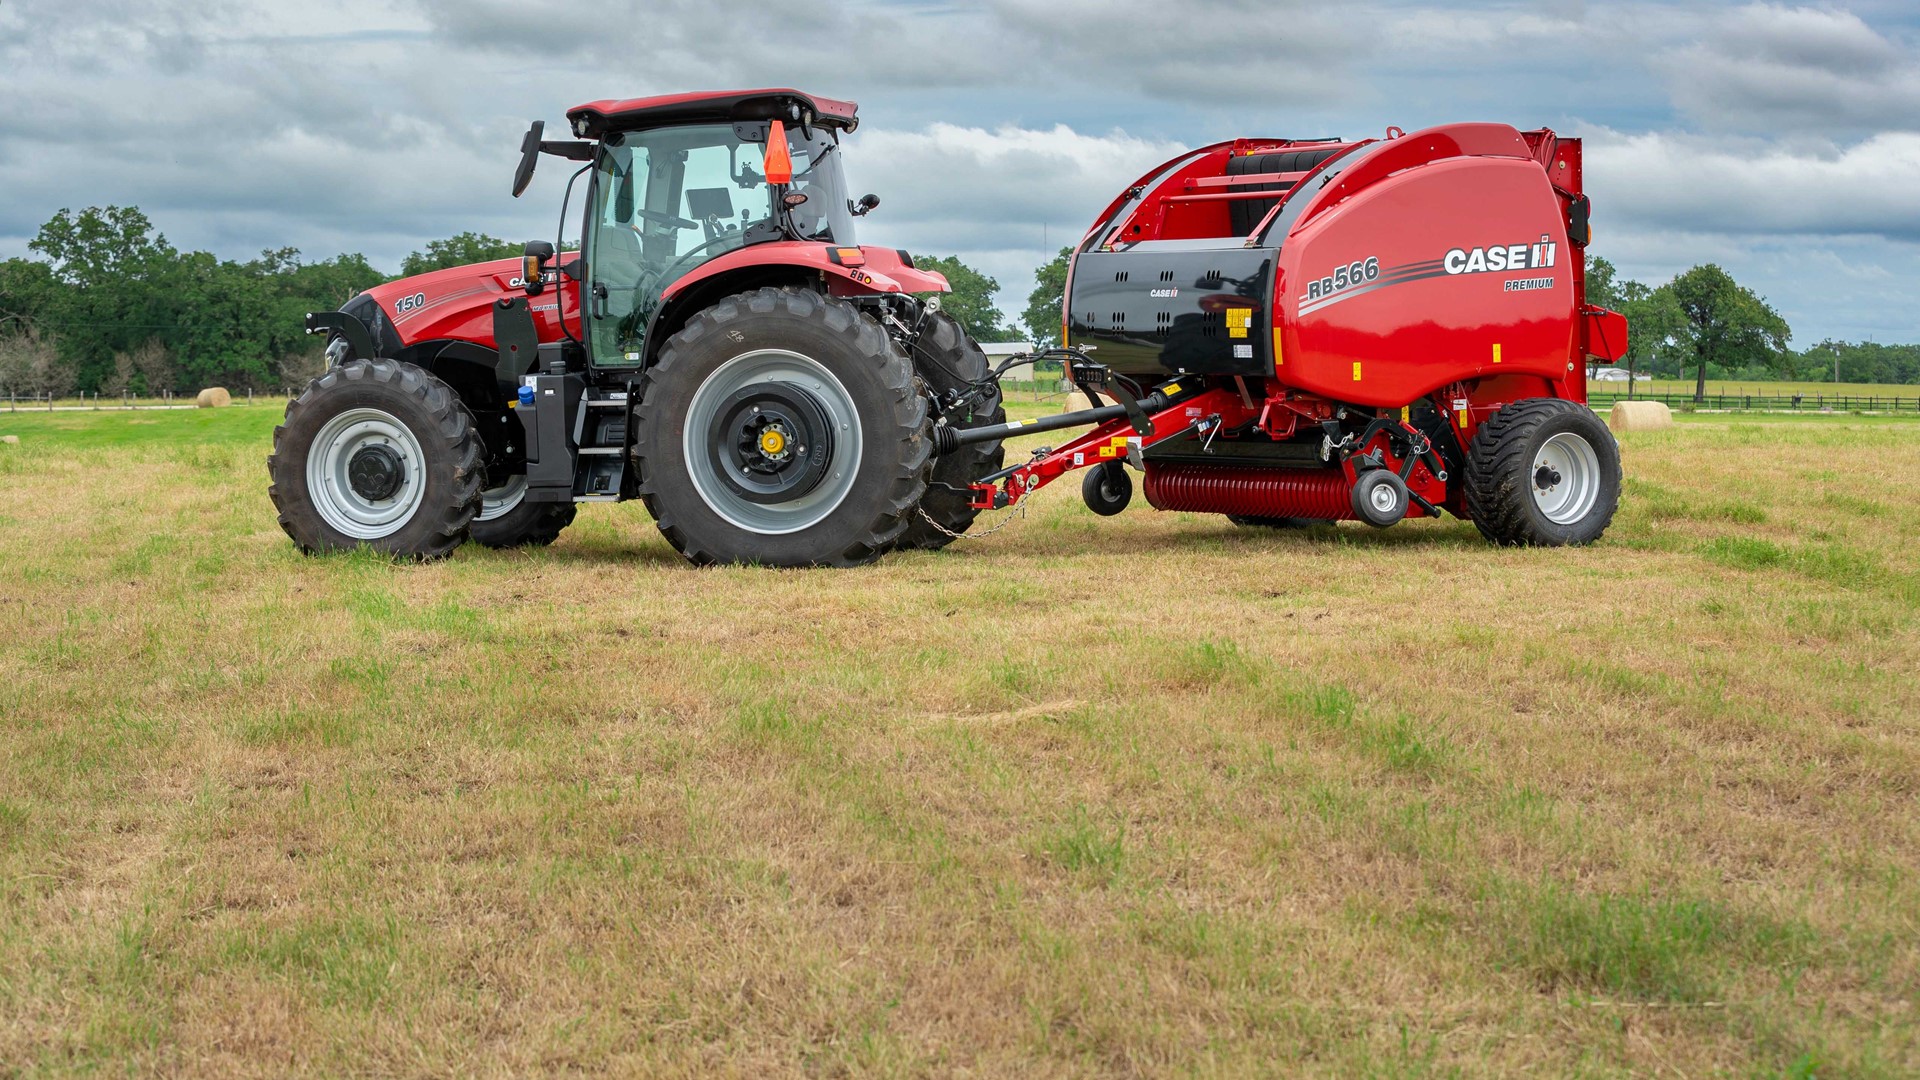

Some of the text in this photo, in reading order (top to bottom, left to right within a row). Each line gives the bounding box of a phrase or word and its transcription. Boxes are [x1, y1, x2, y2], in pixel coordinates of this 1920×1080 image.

[1444, 245, 1527, 275] CASE
[1307, 256, 1379, 300] RB566
[1504, 277, 1555, 292] PREMIUM
[395, 292, 425, 314] 150
[1150, 288, 1170, 298] CASE
